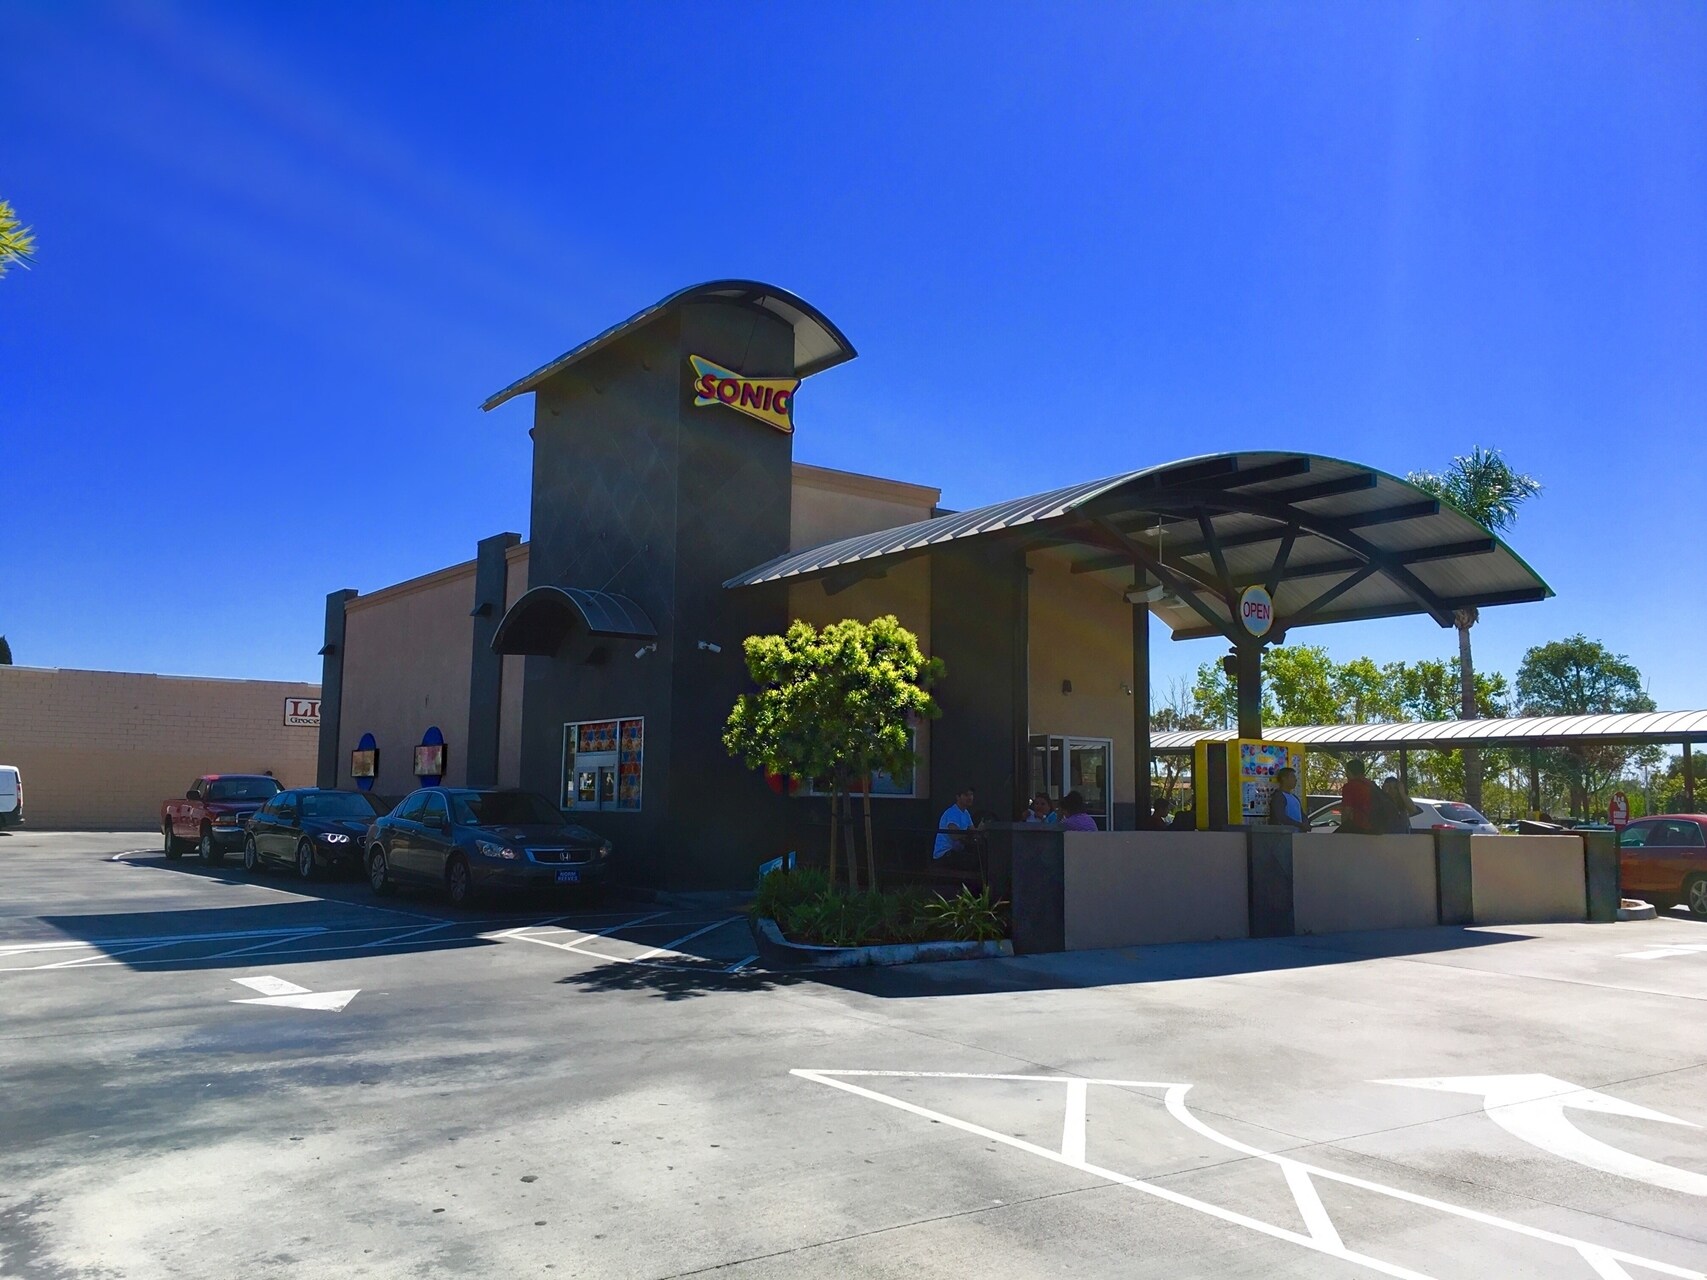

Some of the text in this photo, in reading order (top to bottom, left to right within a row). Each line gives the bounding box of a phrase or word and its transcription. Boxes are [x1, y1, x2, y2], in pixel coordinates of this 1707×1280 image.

[699, 374, 792, 415] SONIC
[1243, 601, 1270, 620] OPEN
[289, 700, 320, 717] LI
[290, 717, 320, 725] Groce
